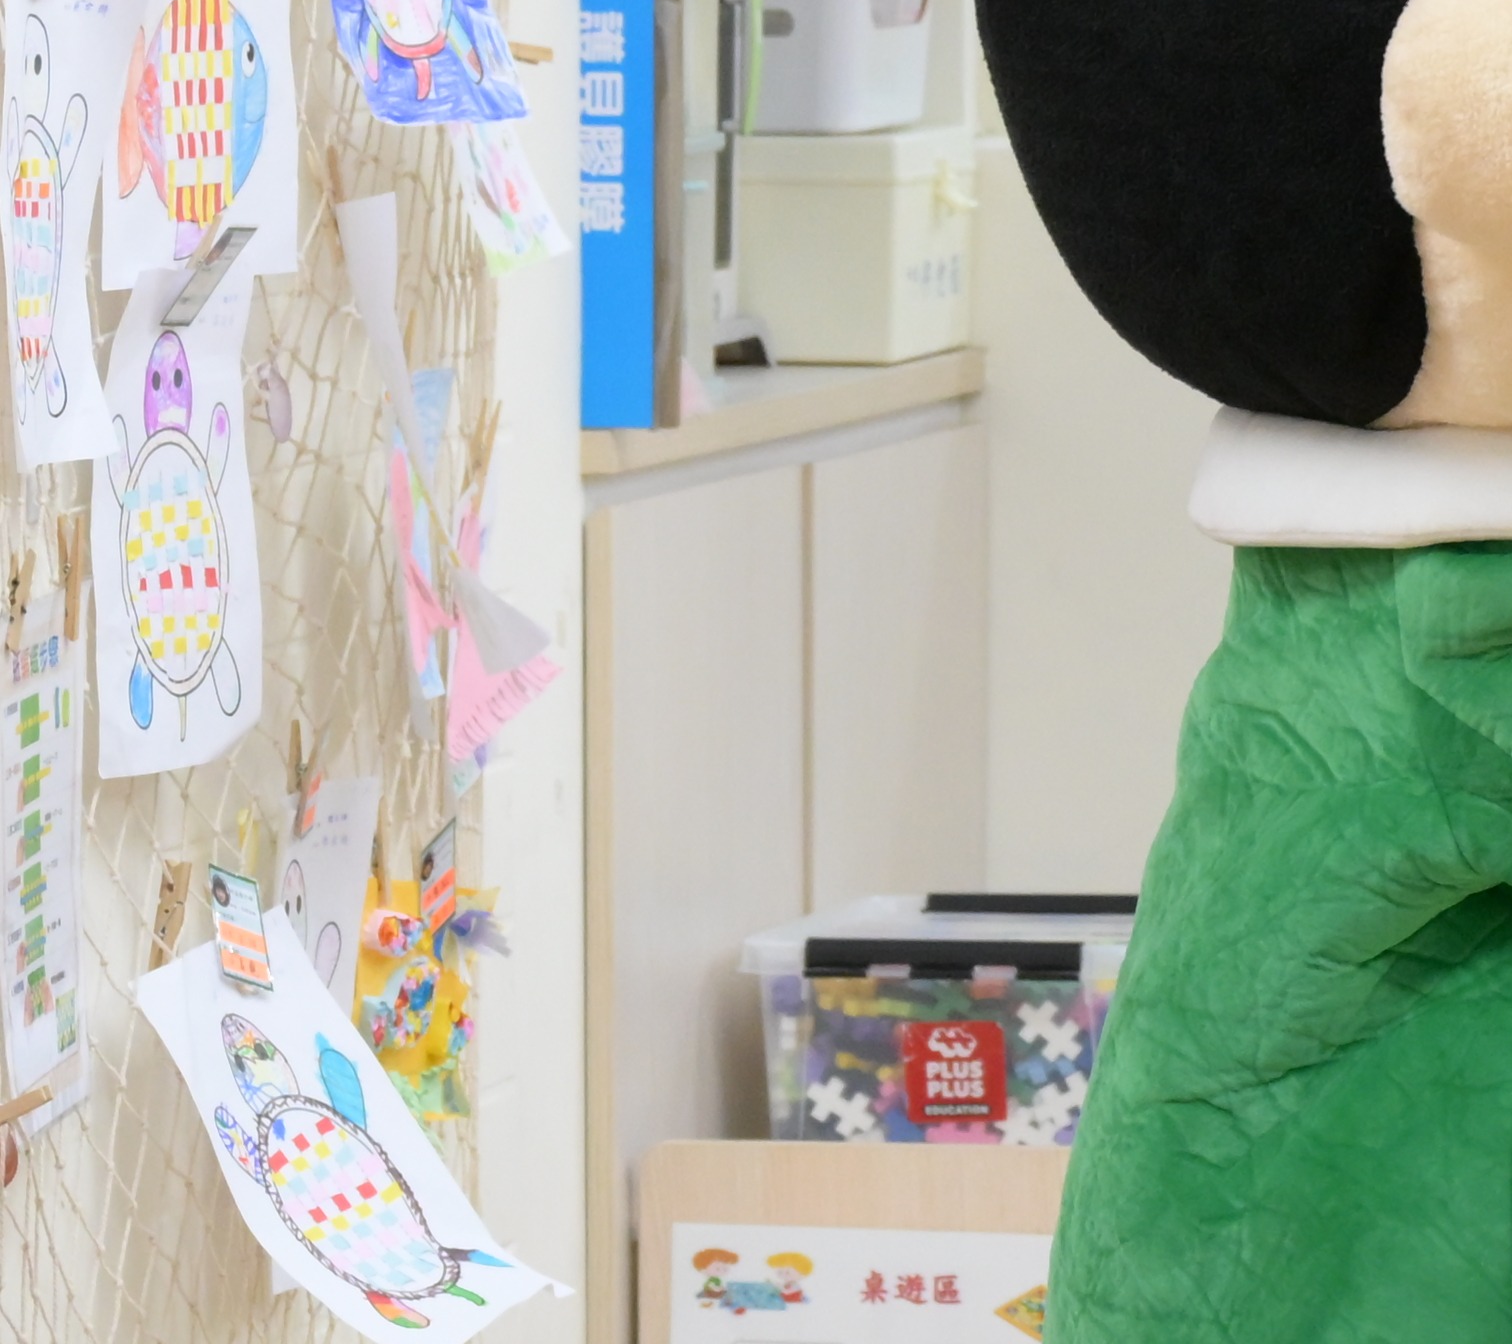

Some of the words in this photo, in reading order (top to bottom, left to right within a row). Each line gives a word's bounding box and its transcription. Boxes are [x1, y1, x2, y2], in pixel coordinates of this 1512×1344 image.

[926, 1060, 983, 1078] PLUS
[927, 1081, 984, 1098] PLUS
[924, 1105, 990, 1116] EDUCATION
[860, 1270, 962, 1305] 桌遊區
